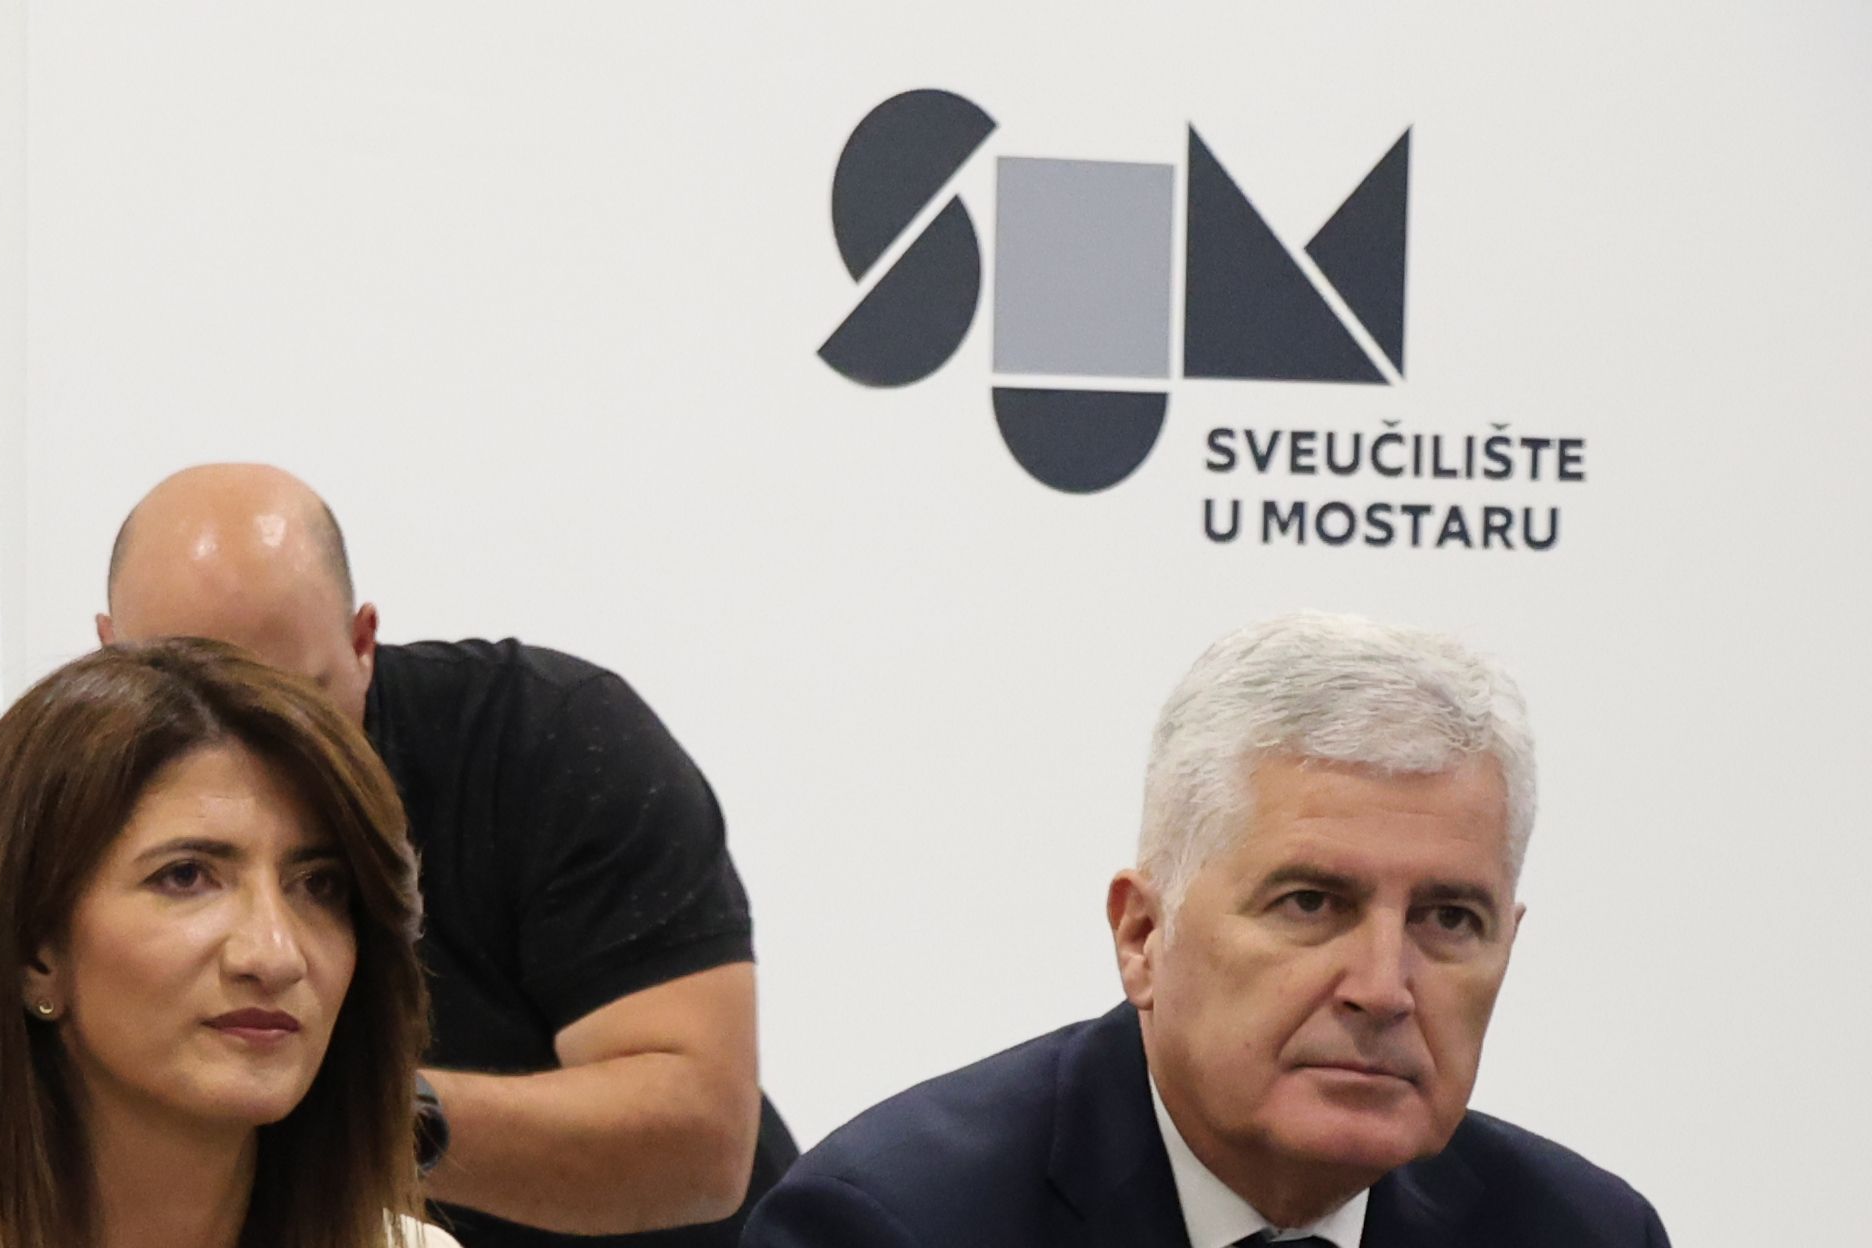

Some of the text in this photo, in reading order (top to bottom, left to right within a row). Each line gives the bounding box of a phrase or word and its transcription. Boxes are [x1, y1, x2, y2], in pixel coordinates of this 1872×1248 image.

[1205, 418, 1587, 482] SVEUČILIŠTE
[1202, 498, 1560, 551] U MOSTARU
